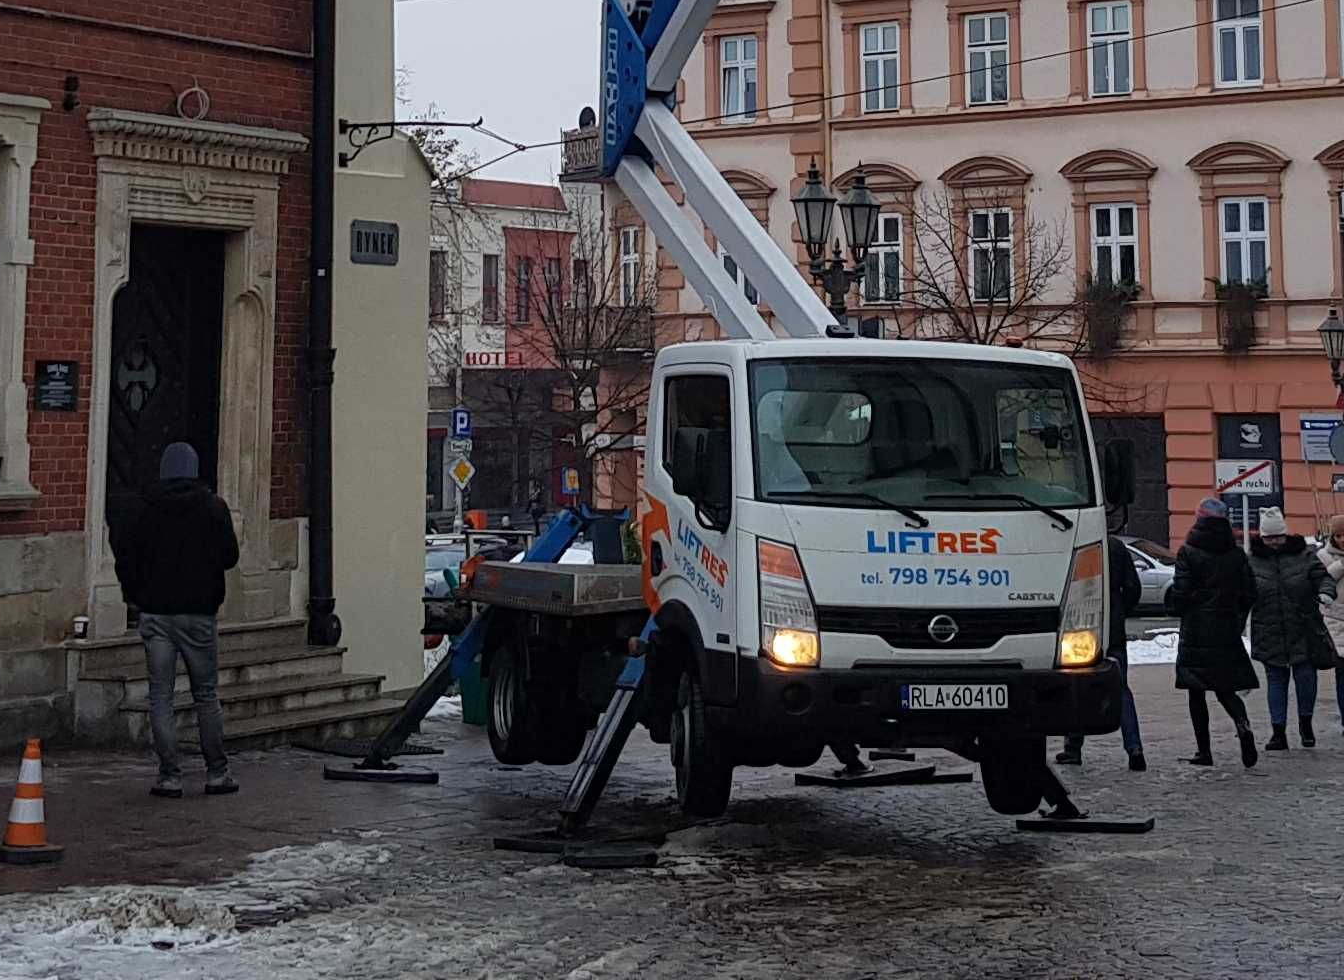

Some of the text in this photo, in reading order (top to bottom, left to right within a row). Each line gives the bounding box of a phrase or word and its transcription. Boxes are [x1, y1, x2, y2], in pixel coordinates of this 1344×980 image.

[356, 230, 394, 254] RYNEK
[465, 351, 525, 366] HOTEL
[457, 412, 469, 434] P
[1245, 478, 1270, 488] ruchu
[861, 568, 1010, 586] tel. 798 754 901
[1008, 593, 1056, 601] CABSTAR
[911, 687, 1006, 707] RLA 60410
